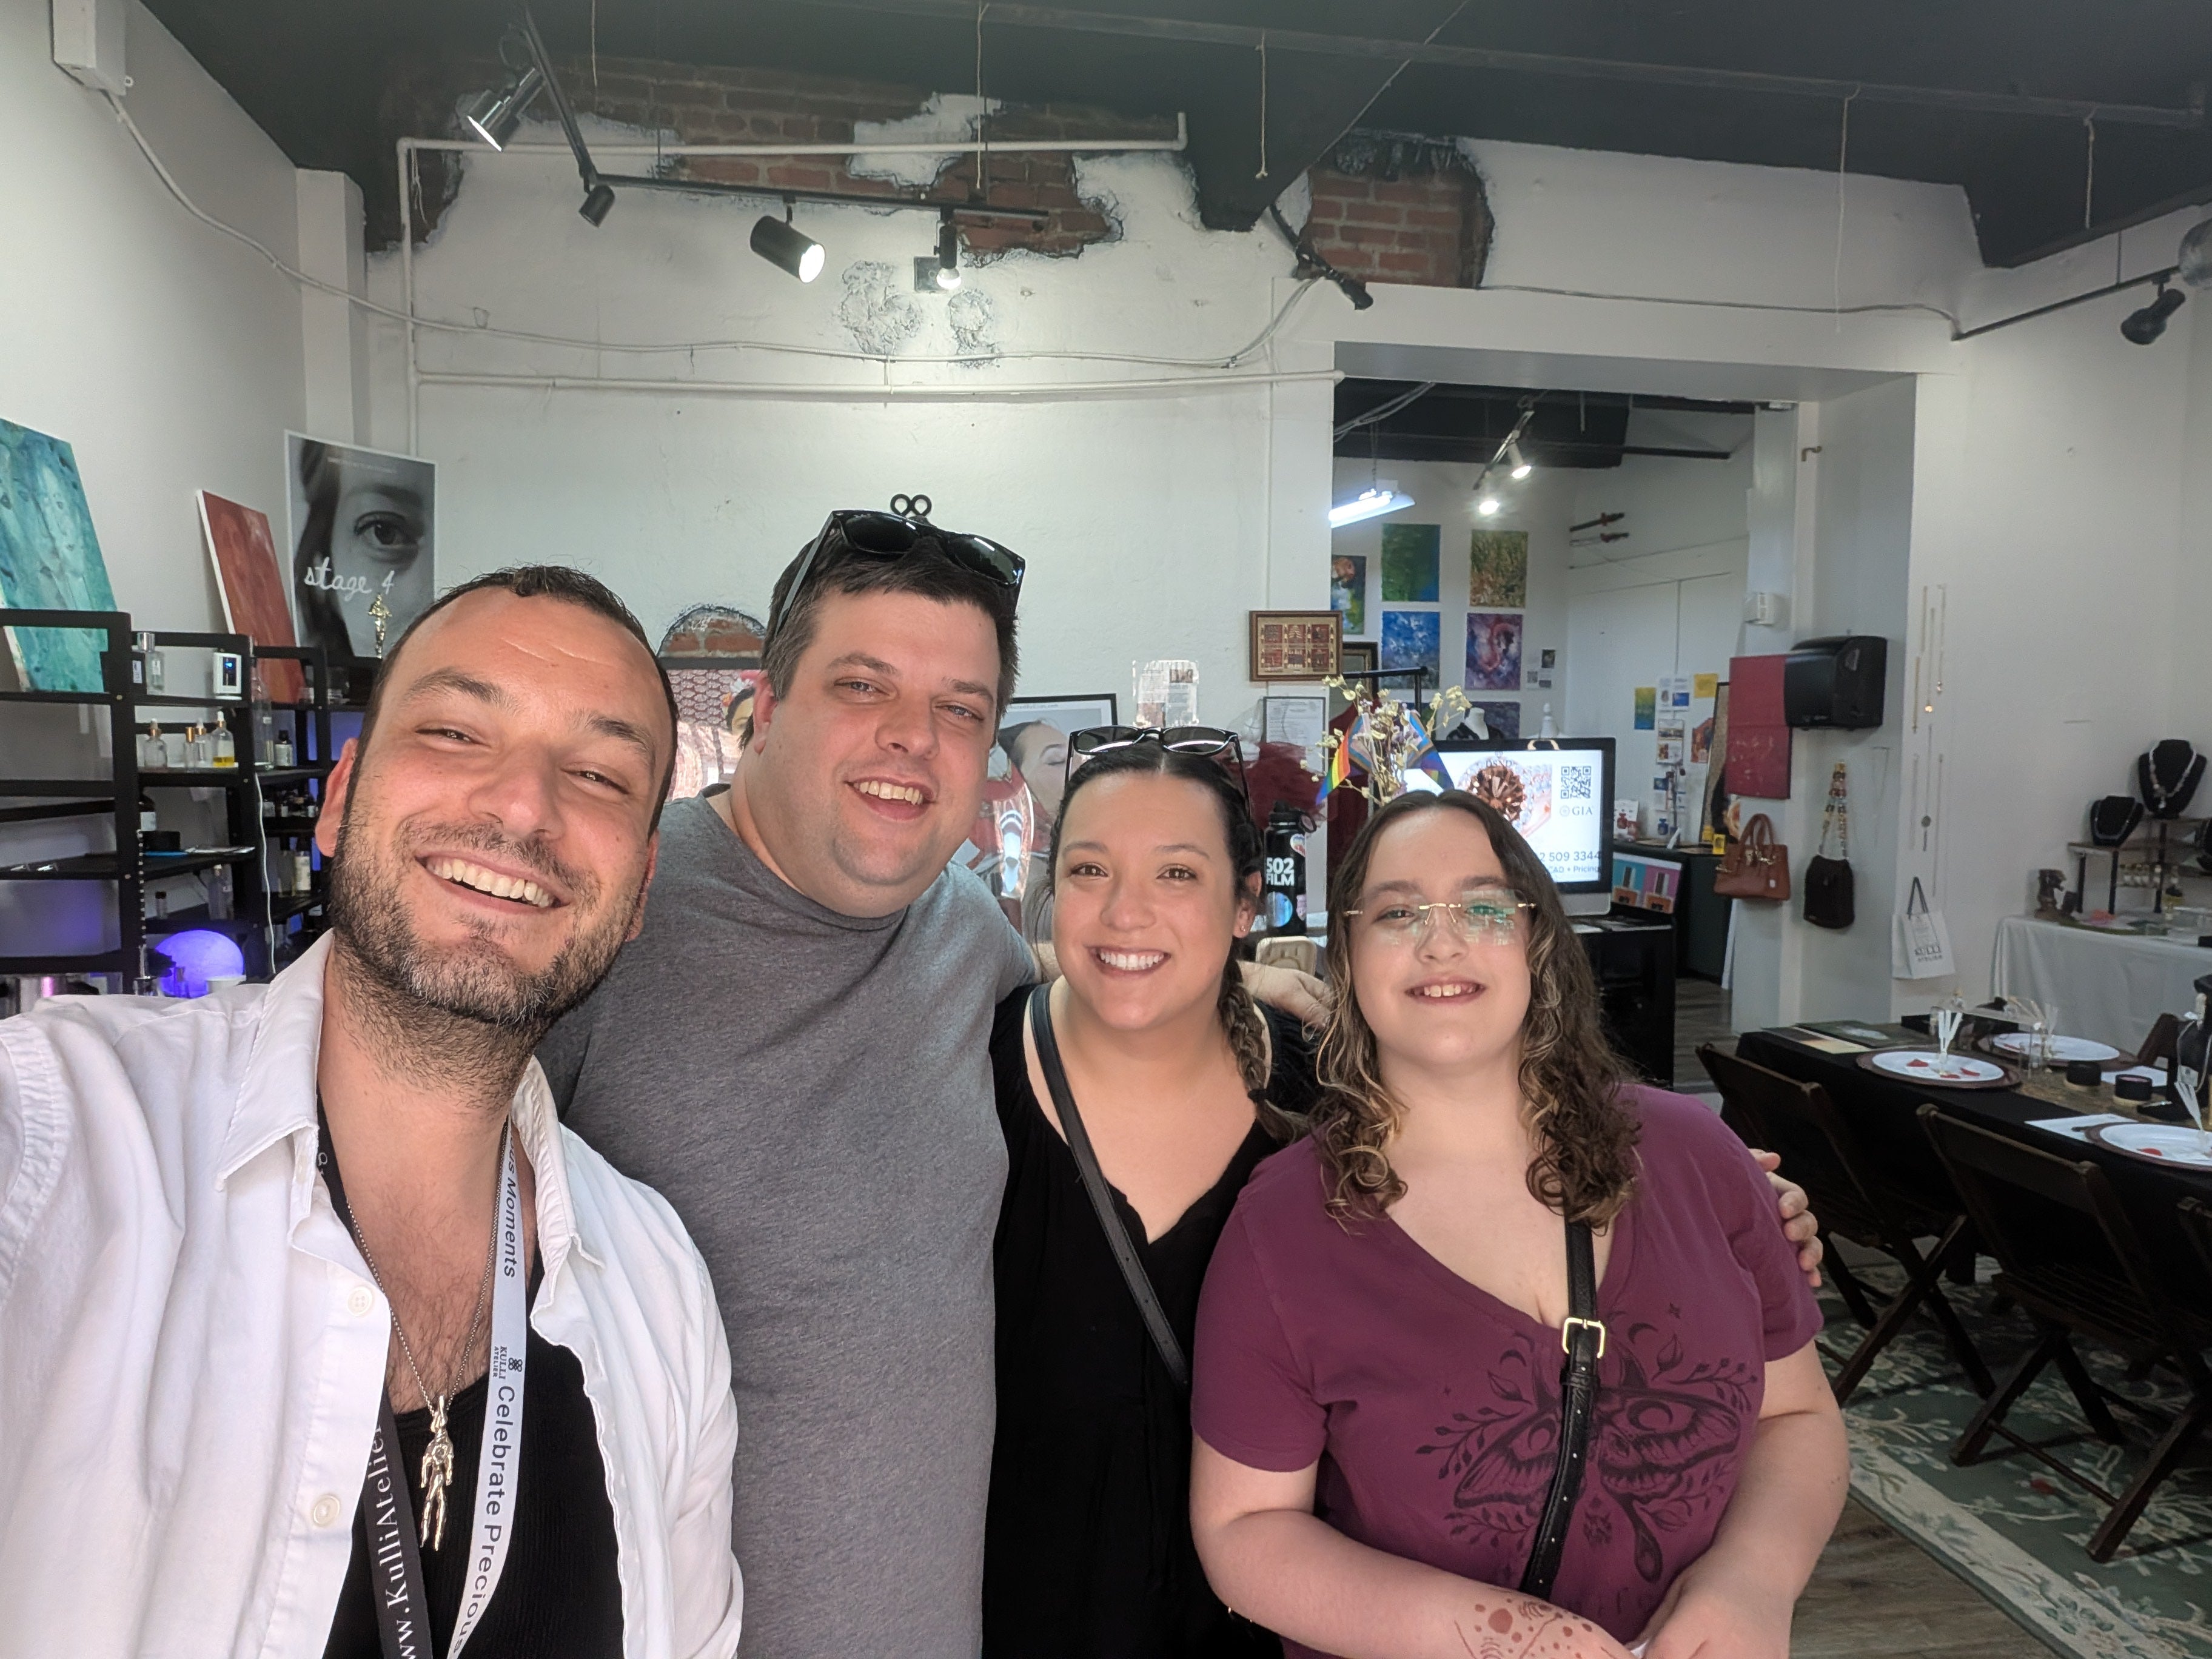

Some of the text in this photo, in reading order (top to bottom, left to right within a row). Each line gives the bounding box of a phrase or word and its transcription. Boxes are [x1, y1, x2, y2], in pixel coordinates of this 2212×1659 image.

[304, 557, 395, 602] stage 4
[1572, 806, 1593, 816] GIA
[1266, 857, 1295, 874] 502
[1549, 852, 1570, 862] 509
[1266, 873, 1295, 886] FILM
[504, 1176, 517, 1278] Moments
[453, 1386, 515, 1654] Celebrate Precious
